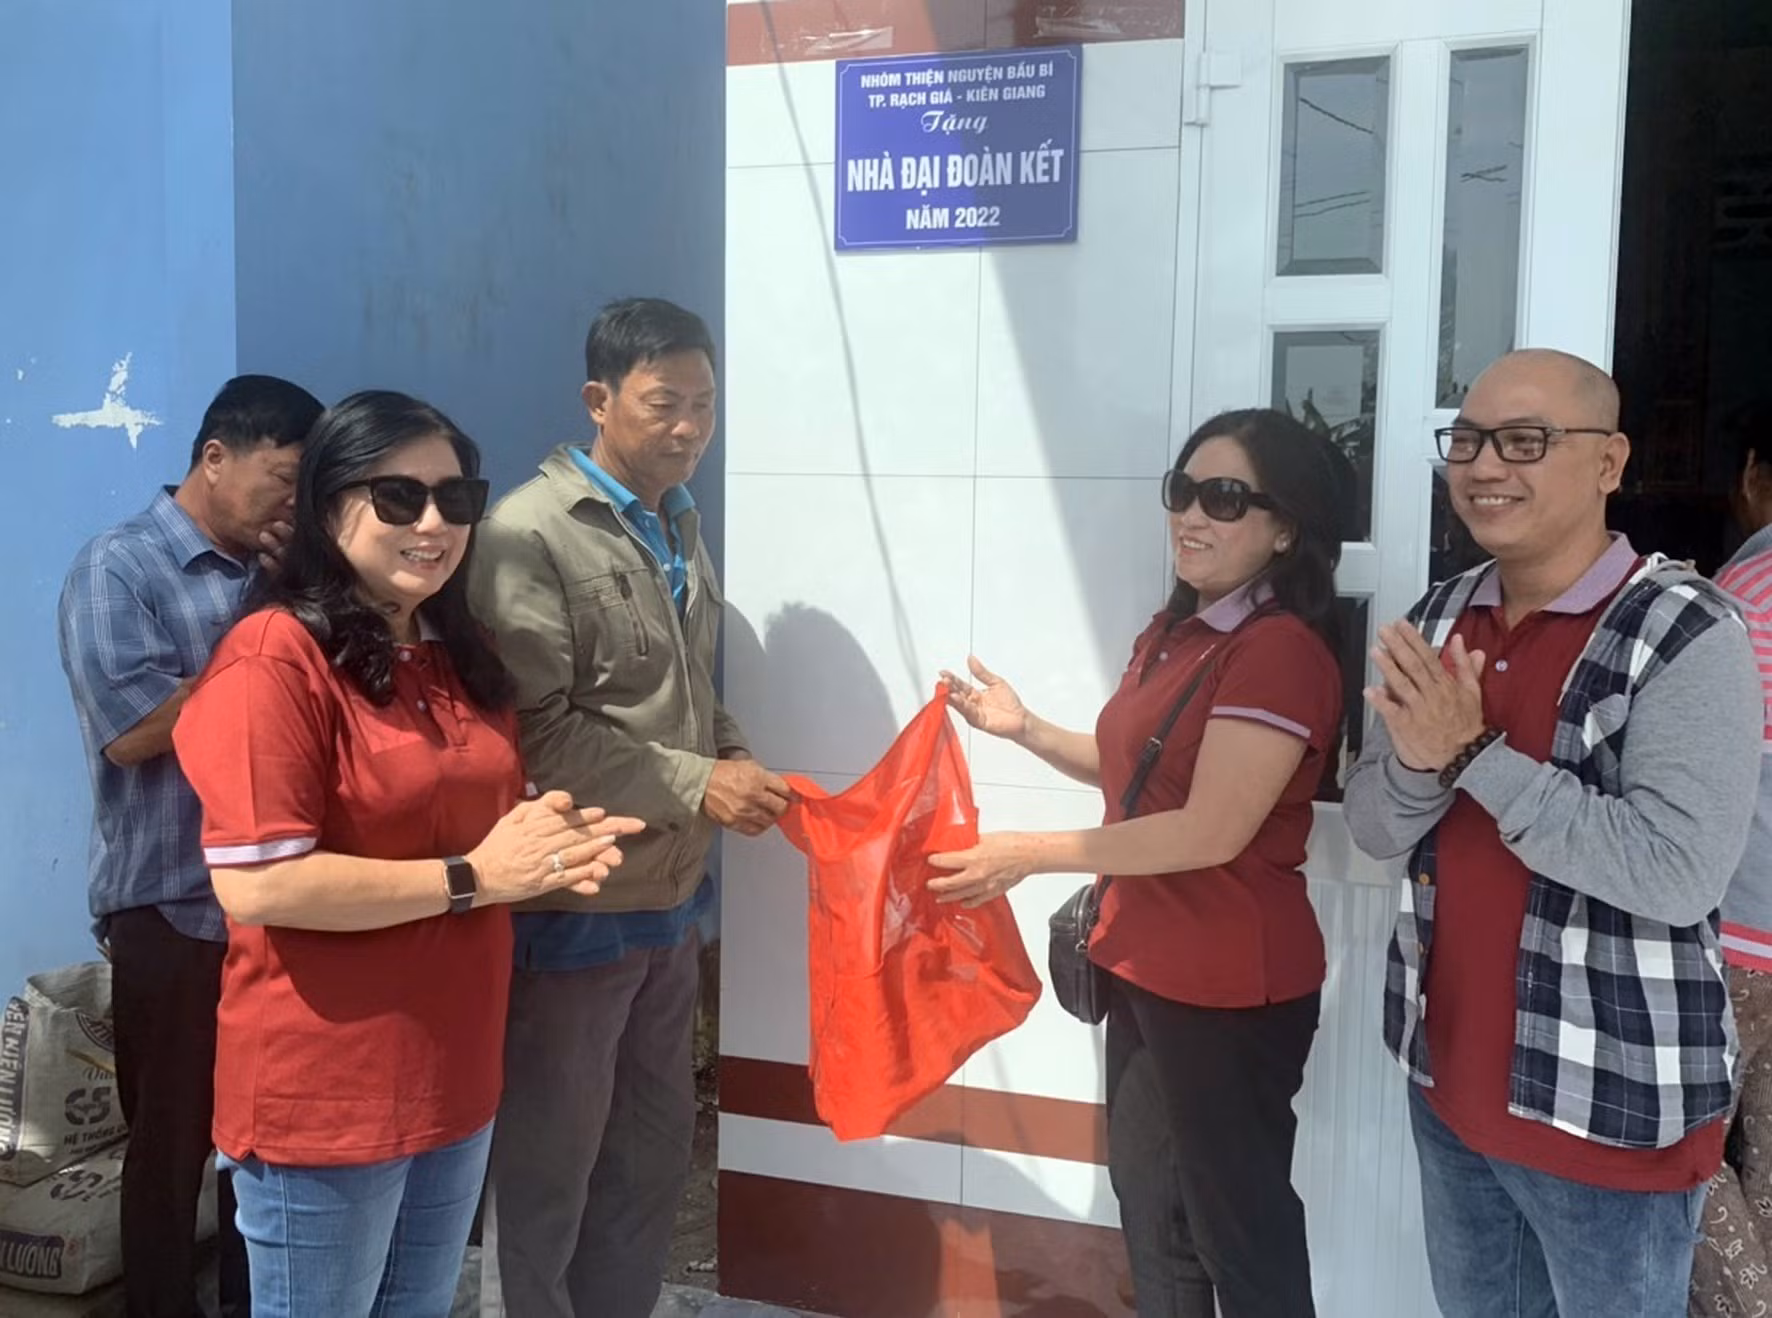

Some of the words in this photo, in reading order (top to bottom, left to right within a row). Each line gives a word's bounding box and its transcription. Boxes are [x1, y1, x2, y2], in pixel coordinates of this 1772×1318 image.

[861, 72, 901, 88] NHÓM
[905, 68, 944, 87] THIỆN
[948, 64, 1003, 84] NGUYỆN
[1039, 60, 1054, 77] BÍ
[868, 94, 886, 108] TP.
[890, 92, 926, 109] RẠCH
[930, 87, 953, 104] GIÁ
[966, 86, 999, 102] KIÊN
[1003, 84, 1046, 100] GIANG
[921, 110, 988, 135] Tặng
[847, 151, 895, 192] NHÀ
[901, 155, 940, 196] ĐẠI
[947, 146, 1013, 189] ĐOÀN
[1020, 138, 1065, 185] KẾT
[906, 204, 949, 230] NĂM
[954, 206, 1001, 229] 2022
